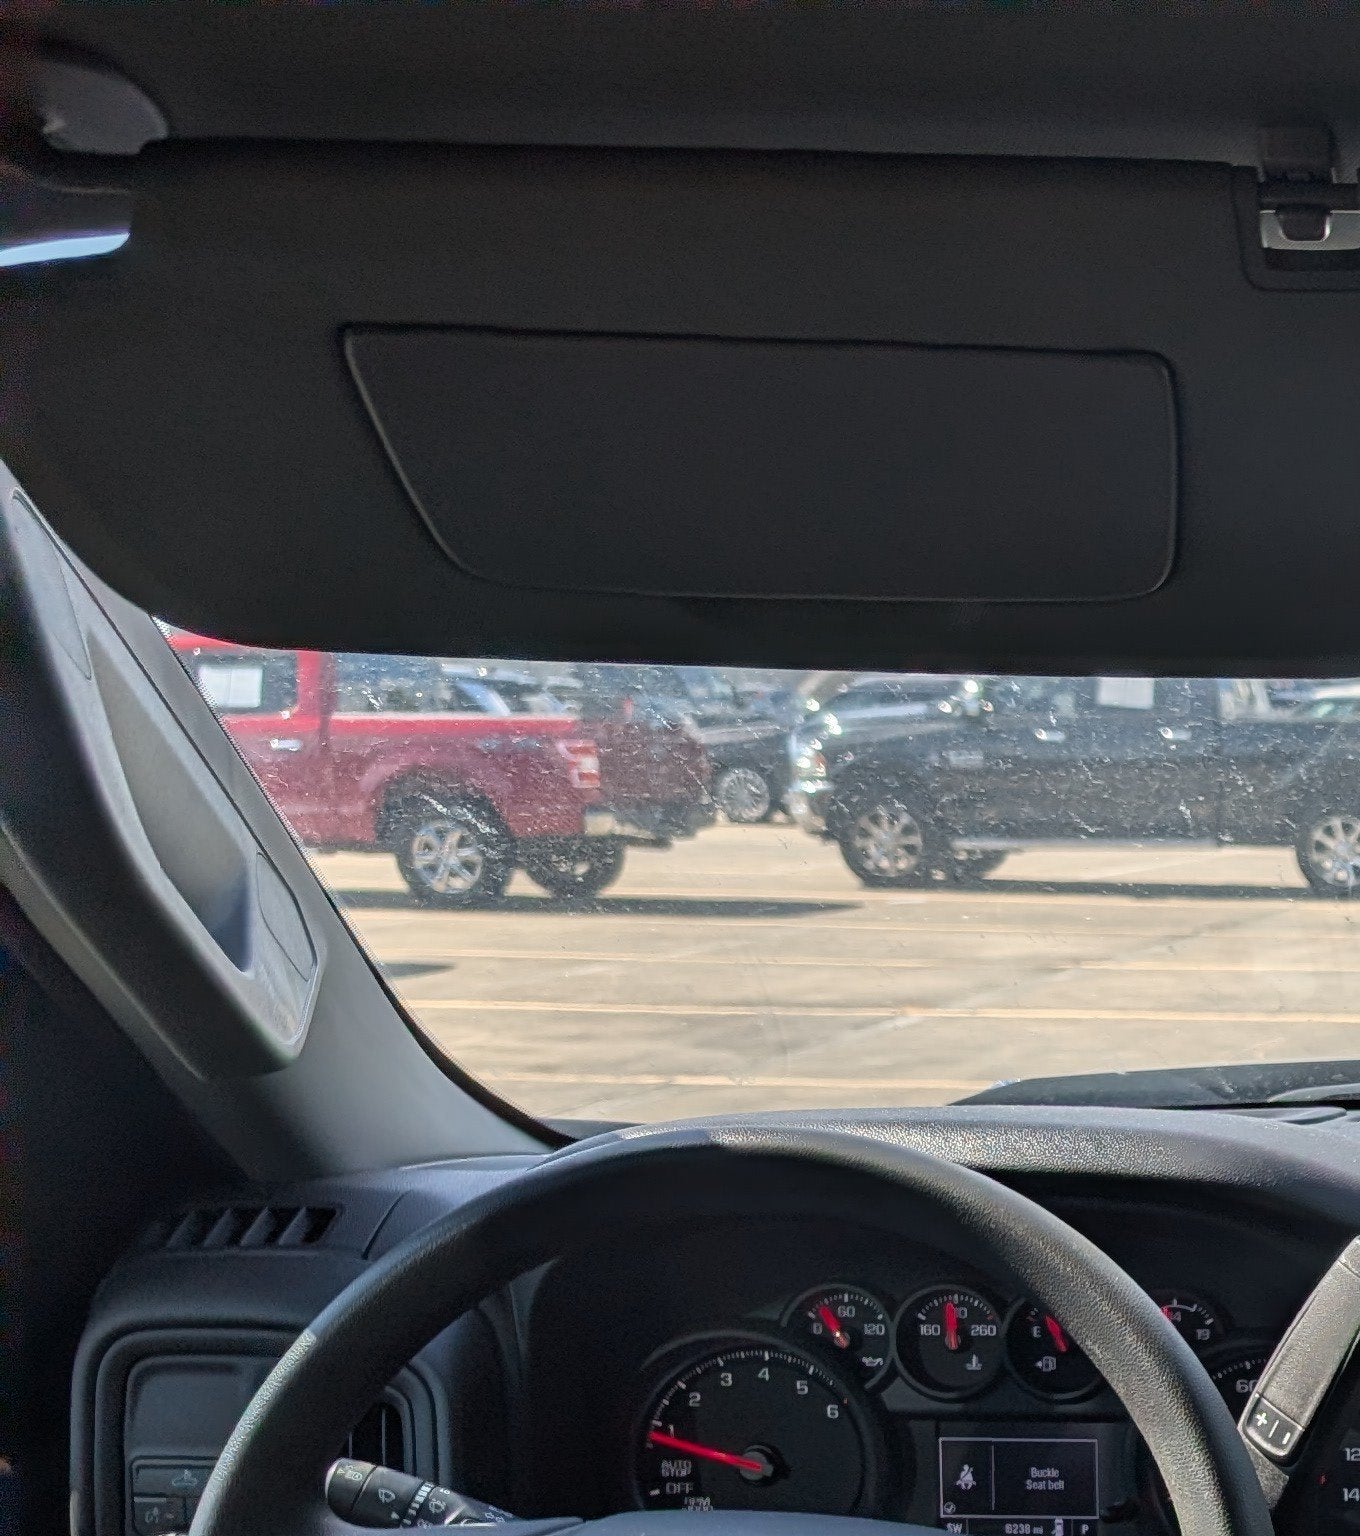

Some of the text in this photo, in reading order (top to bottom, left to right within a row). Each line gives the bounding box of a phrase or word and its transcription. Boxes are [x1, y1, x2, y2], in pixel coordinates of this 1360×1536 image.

[837, 1305, 855, 1318] 60
[863, 1323, 885, 1336] 120
[920, 1324, 940, 1336] 160
[970, 1324, 997, 1336] 260
[720, 1372, 733, 1387] 3
[758, 1367, 770, 1381] 4
[796, 1380, 809, 1395] 5
[688, 1392, 701, 1407] 2
[826, 1404, 839, 1419] 6
[1030, 1466, 1060, 1478] Buckle
[1026, 1479, 1064, 1490] Seat belt
[1080, 1524, 1090, 1536] P
